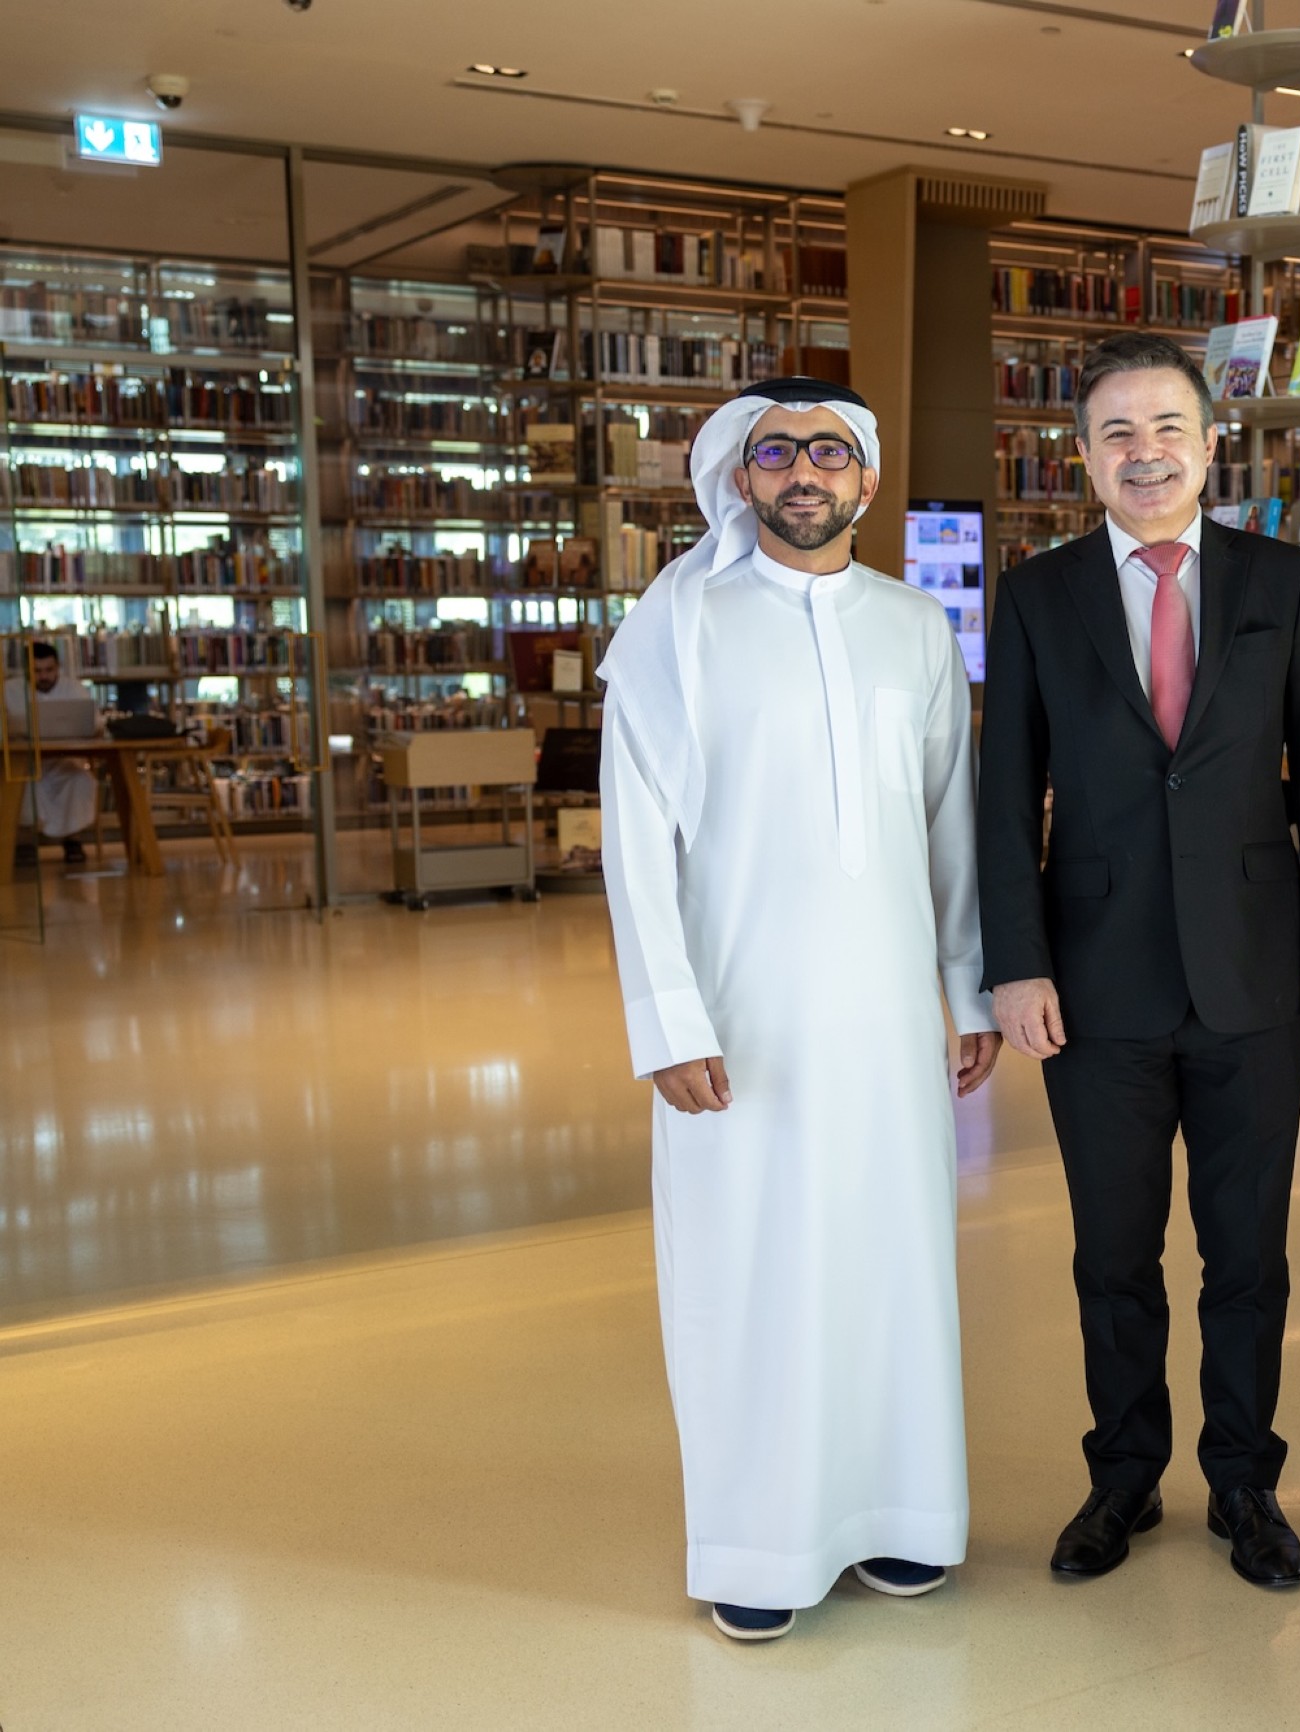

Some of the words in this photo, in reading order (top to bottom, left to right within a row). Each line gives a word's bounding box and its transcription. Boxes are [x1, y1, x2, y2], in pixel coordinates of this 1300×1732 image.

[1260, 151, 1295, 165] FIRST
[1260, 166, 1289, 178] CELL
[1239, 171, 1247, 213] PICKS
